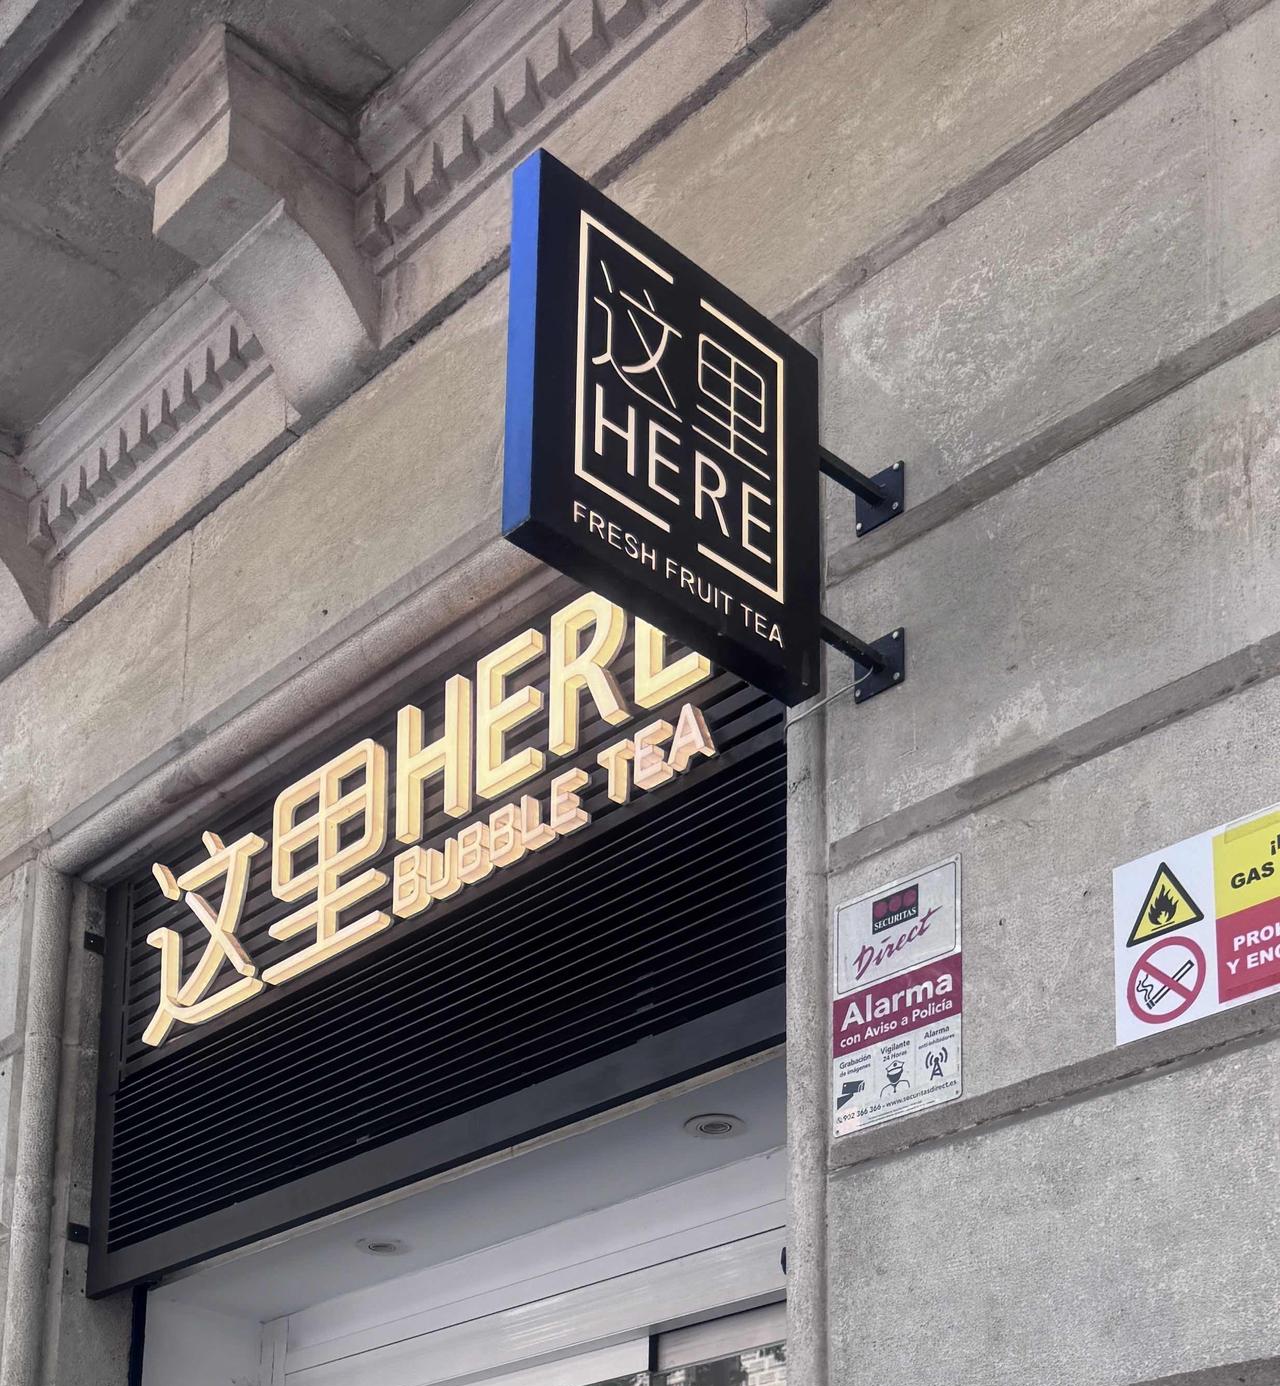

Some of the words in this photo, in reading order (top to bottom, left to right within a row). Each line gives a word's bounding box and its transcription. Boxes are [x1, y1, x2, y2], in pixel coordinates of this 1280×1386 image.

[591, 260, 771, 481] 这里
[594, 383, 772, 564] HERE
[574, 500, 657, 570] FRESH
[665, 561, 733, 616] FRUIT
[740, 603, 785, 649] TEA
[392, 766, 592, 920] BUBBLE
[597, 702, 717, 805] TEA
[141, 737, 396, 1048] 这里
[1231, 861, 1275, 889] GAS
[873, 906, 917, 932] SECURITAS
[853, 905, 943, 981] Direct
[1226, 957, 1240, 975] Y
[840, 972, 953, 1032] Alarma
[840, 1034, 861, 1048] con
[864, 1019, 898, 1040] Aviso
[900, 1015, 909, 1026] a
[911, 998, 953, 1022] Policía
[923, 1025, 950, 1039] Alarma
[840, 1053, 872, 1070] Grabación
[880, 1040, 911, 1054] Vigilante
[890, 1050, 907, 1060] Horas
[847, 1063, 871, 1076] imágenes
